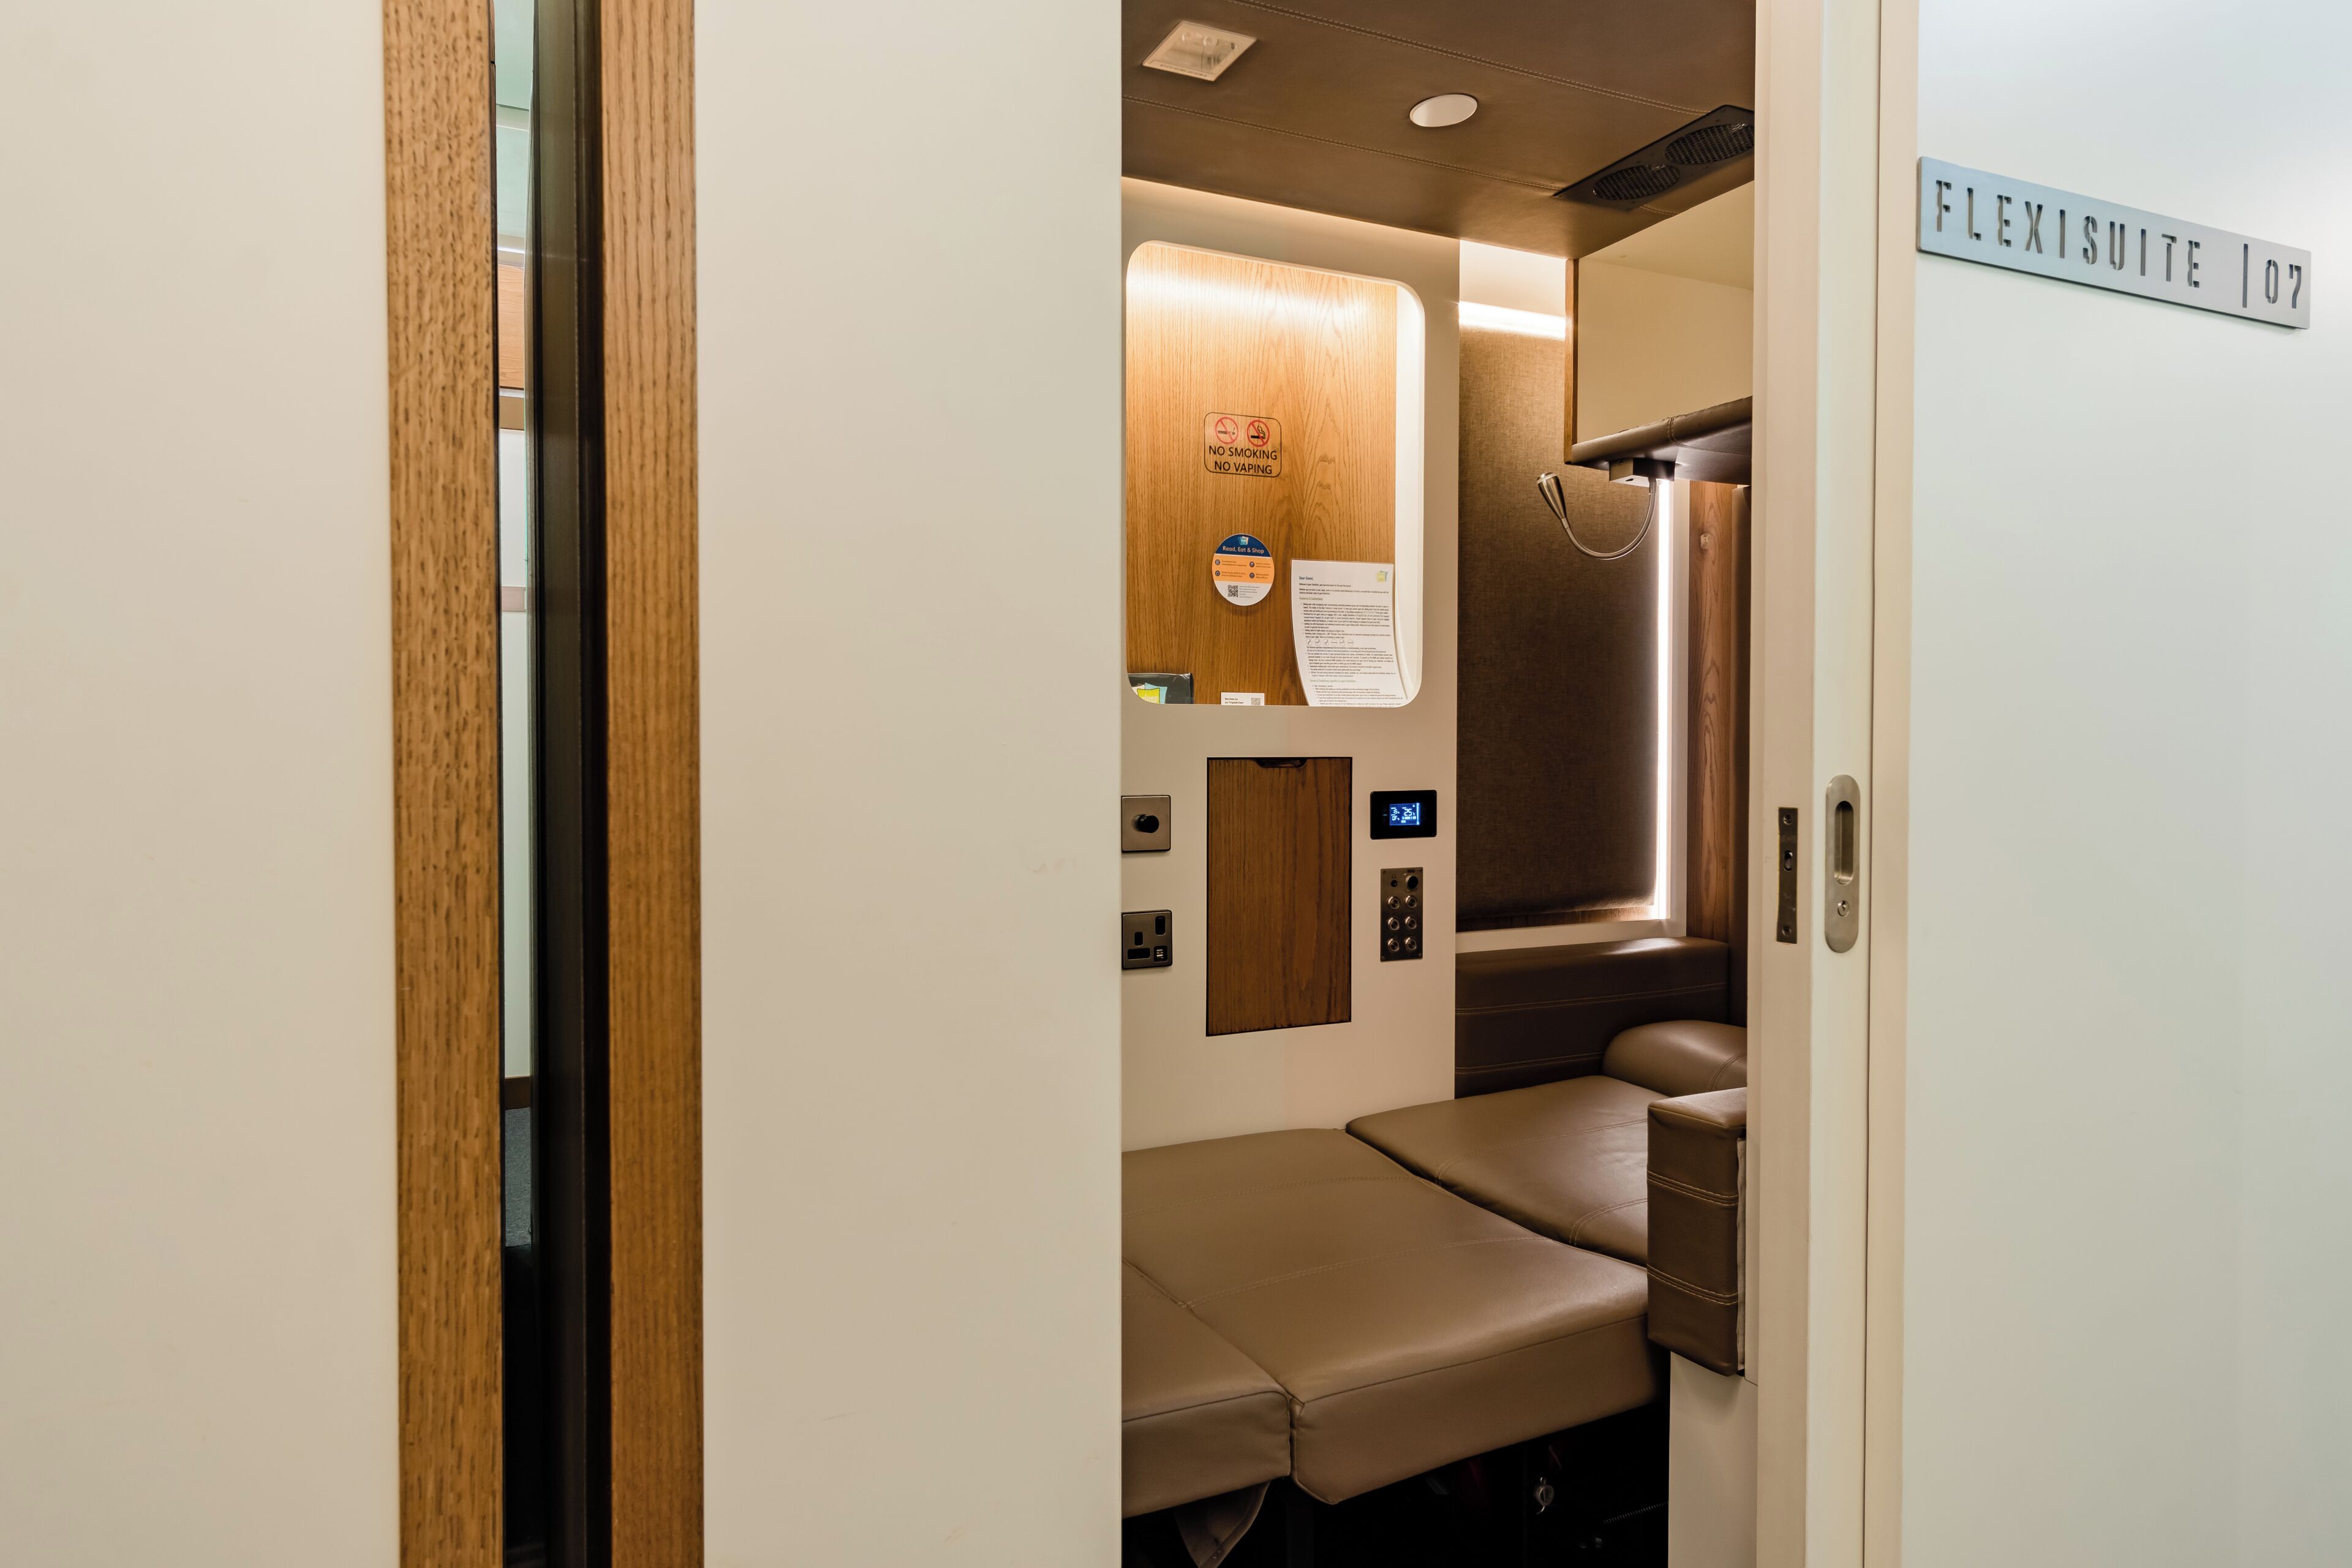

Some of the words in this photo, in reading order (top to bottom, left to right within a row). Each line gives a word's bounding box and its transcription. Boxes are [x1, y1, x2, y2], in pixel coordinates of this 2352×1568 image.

[1936, 179, 2199, 288] FLEXISUITE
[1209, 445, 1224, 456] NO
[1229, 447, 1277, 460] SMOKING
[1215, 461, 1231, 471] NO
[1234, 462, 1272, 474] VAPING
